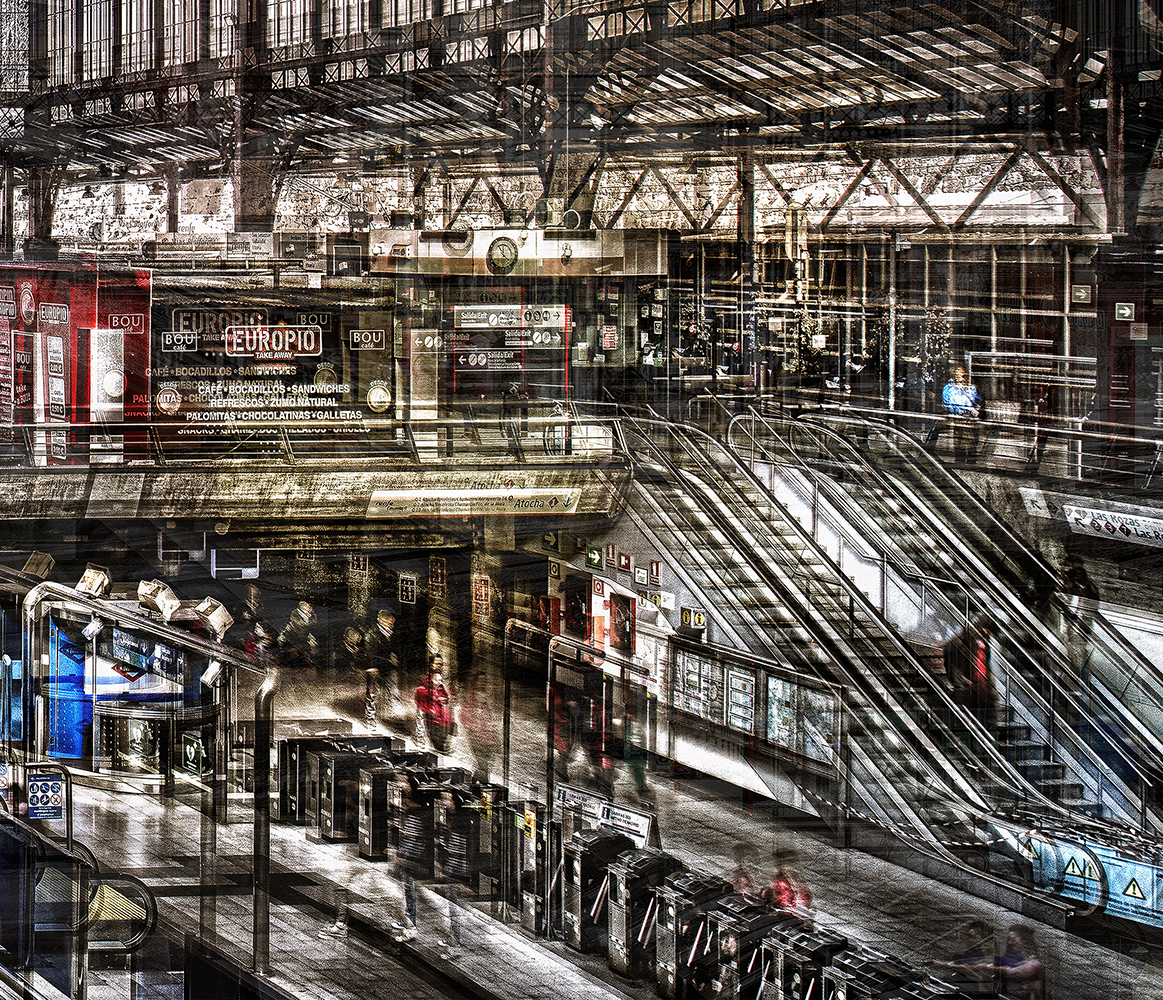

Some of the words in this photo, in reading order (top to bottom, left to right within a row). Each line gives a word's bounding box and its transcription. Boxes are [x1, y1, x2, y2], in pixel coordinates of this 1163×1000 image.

[112, 316, 141, 327] BOU
[300, 314, 328, 325] BOU
[165, 334, 194, 345] BOU
[233, 330, 315, 351] EUROPIO
[353, 332, 381, 343] BOU
[16, 352, 31, 365] BOU
[255, 351, 273, 359] TAKE
[273, 351, 293, 359] AWAY
[145, 366, 170, 377] CAFÉ
[175, 367, 232, 377] BOCADILLOS
[238, 366, 297, 376] SANDWICHES
[198, 384, 222, 394] CAFÉ
[230, 385, 286, 394] BOCADILLOS
[292, 384, 350, 394] SANDWICHES
[210, 398, 264, 408] REFRESCOS
[270, 398, 297, 408] ZUMO
[298, 398, 339, 407] NATURAL
[186, 411, 236, 421] PALOMITAS
[242, 411, 312, 421] CHOCOLATINAS
[317, 410, 363, 420] GALLETAS
[514, 498, 545, 508] Atocha
[1134, 527, 1152, 539] Las
